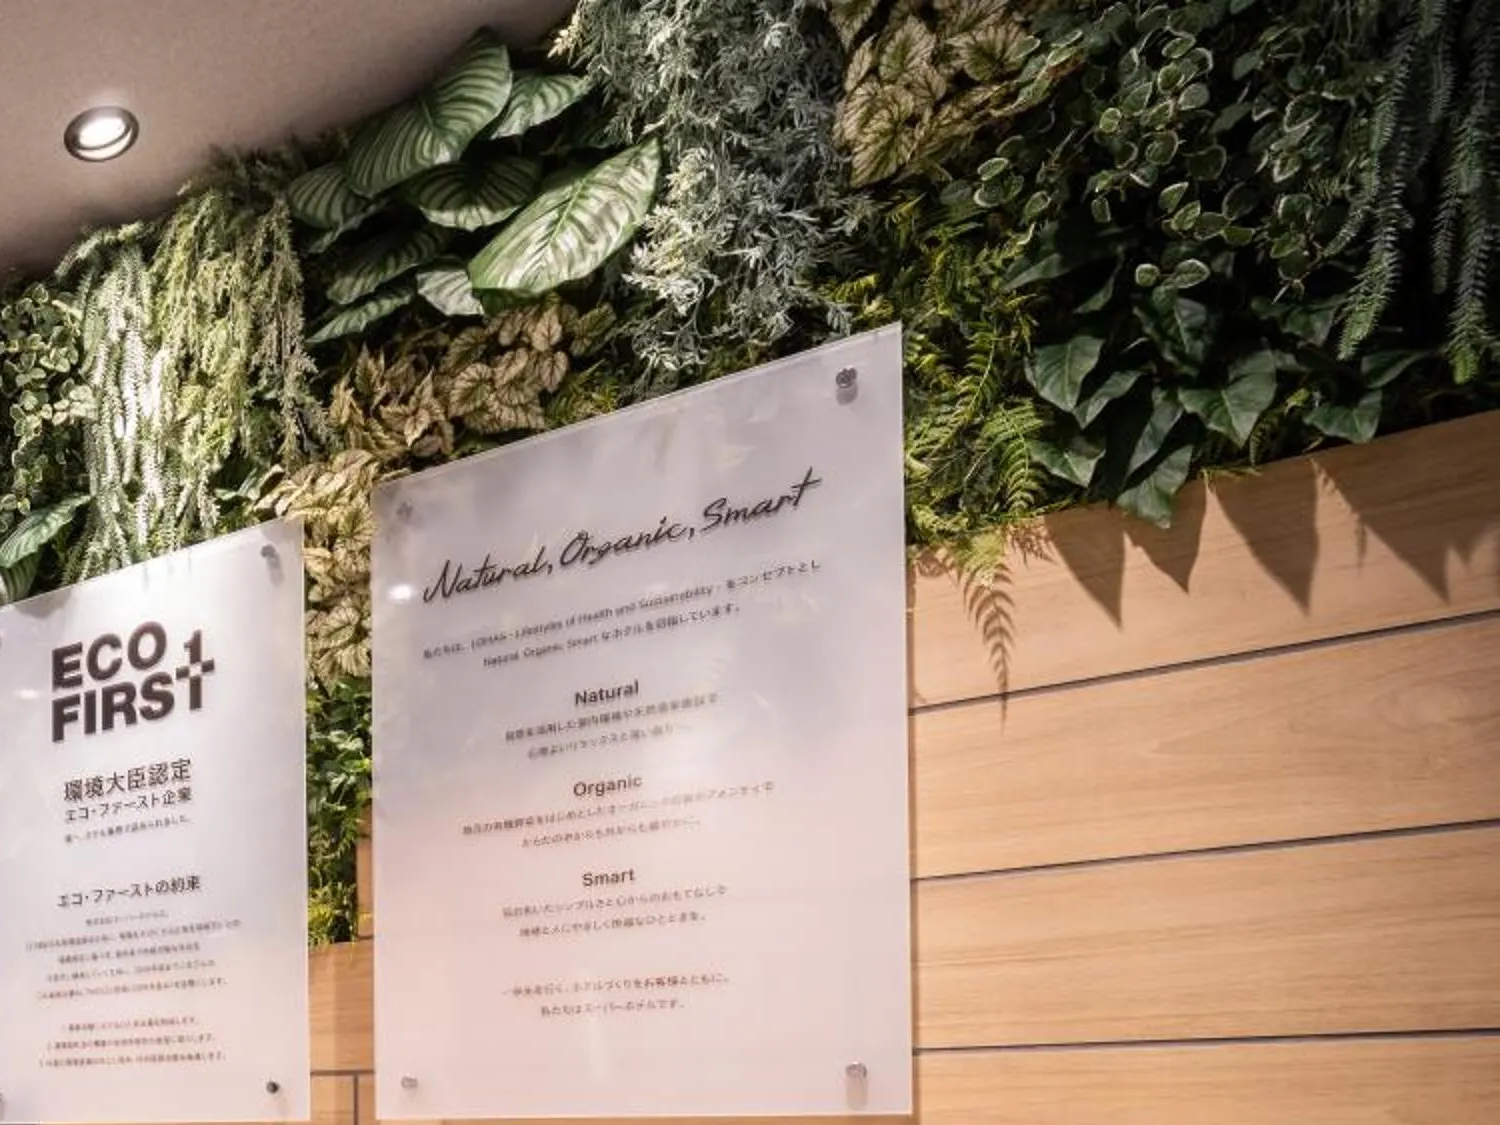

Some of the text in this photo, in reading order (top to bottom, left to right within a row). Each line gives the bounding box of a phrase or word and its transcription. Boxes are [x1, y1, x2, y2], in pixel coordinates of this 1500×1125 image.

[423, 466, 823, 603] Natural, Organic, Smart
[52, 621, 168, 692] ECO
[575, 680, 639, 706] Natural
[64, 757, 192, 802] 環境大臣認定
[573, 774, 644, 799] Organic
[57, 874, 201, 909] エコ・ファーストの約束
[581, 868, 637, 888] Smart
